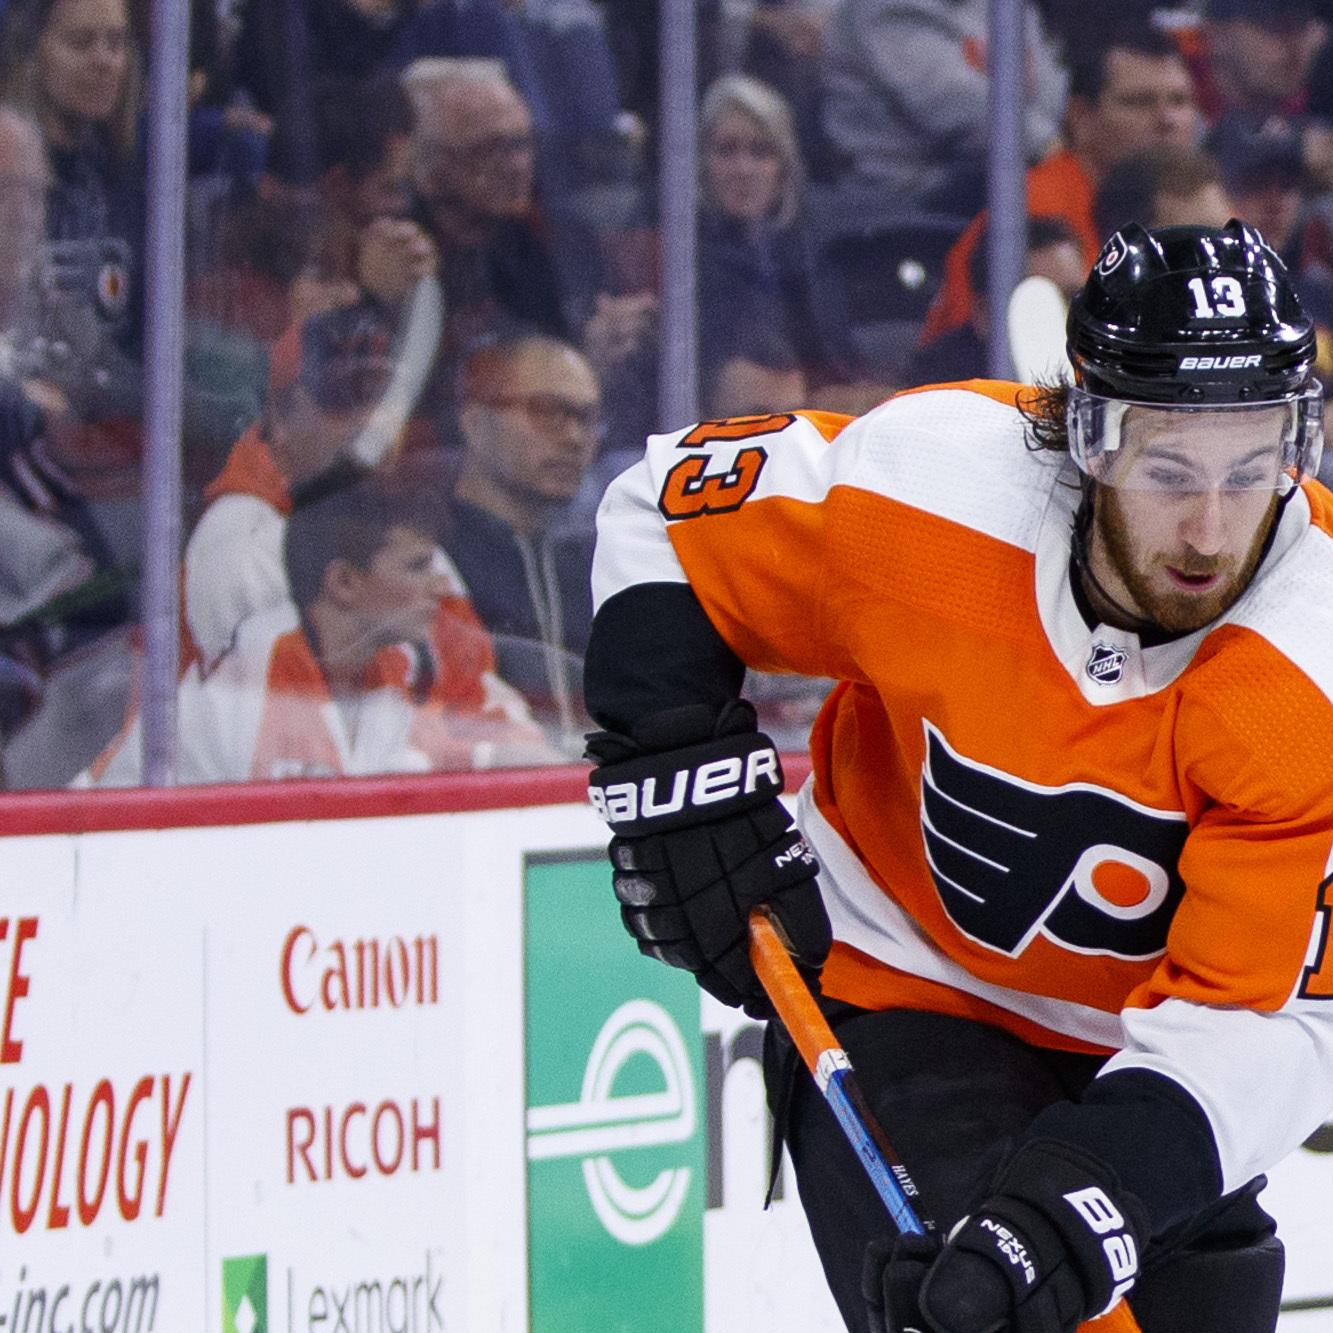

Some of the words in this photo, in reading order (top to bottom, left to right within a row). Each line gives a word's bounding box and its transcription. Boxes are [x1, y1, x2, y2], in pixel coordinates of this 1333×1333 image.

[1188, 277, 1246, 318] 13
[1179, 354, 1262, 370] BAUER
[657, 413, 797, 521] 13
[0, 915, 39, 1065] E
[280, 924, 439, 1015] Canon
[285, 1096, 441, 1184] RICOH
[892, 1164, 919, 1197] HAYES
[980, 1218, 1036, 1285] NEXUS
